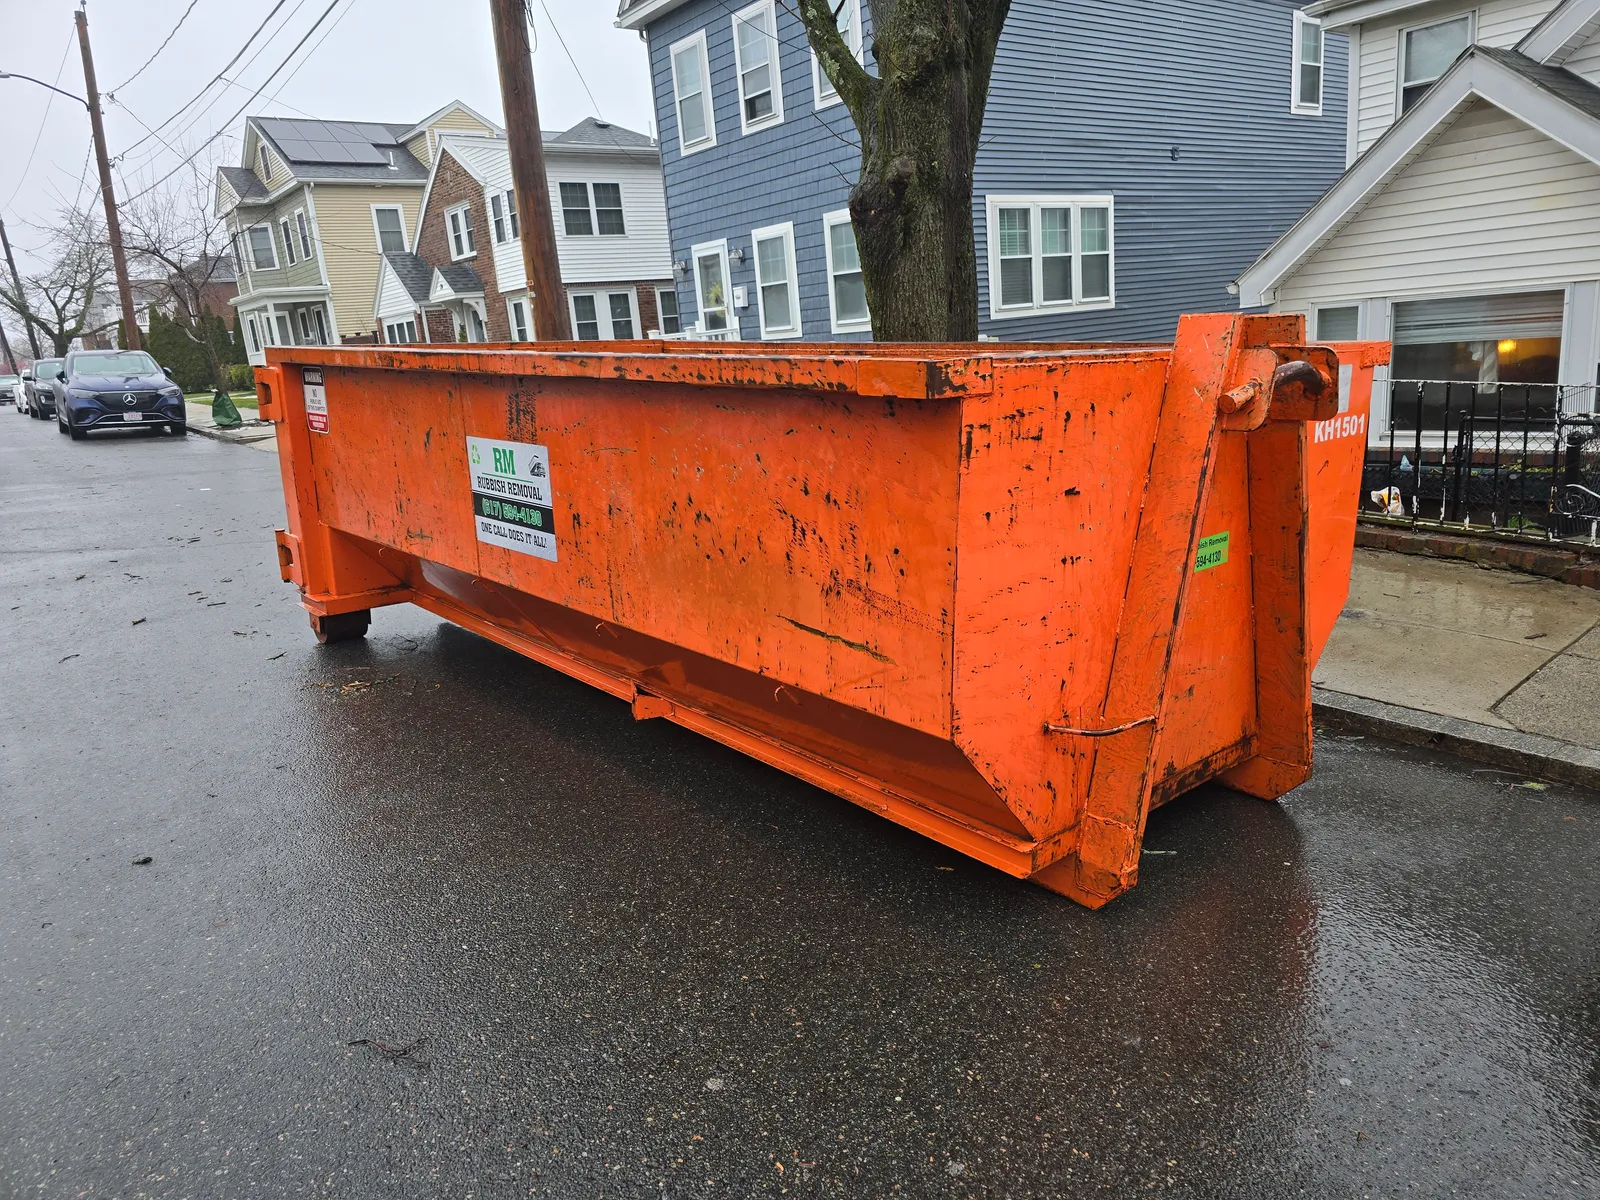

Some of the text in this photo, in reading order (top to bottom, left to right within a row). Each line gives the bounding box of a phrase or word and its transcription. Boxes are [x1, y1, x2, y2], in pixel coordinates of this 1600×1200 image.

[304, 371, 322, 383] WARNING
[1314, 413, 1366, 444] KH1501
[492, 447, 516, 475] RM
[477, 476, 543, 501] RUBBISH REMOVAL
[482, 497, 543, 527] (617) 594-4130
[481, 521, 548, 549] ONE CALL DOES IT ALL!
[1209, 534, 1229, 546] Removal
